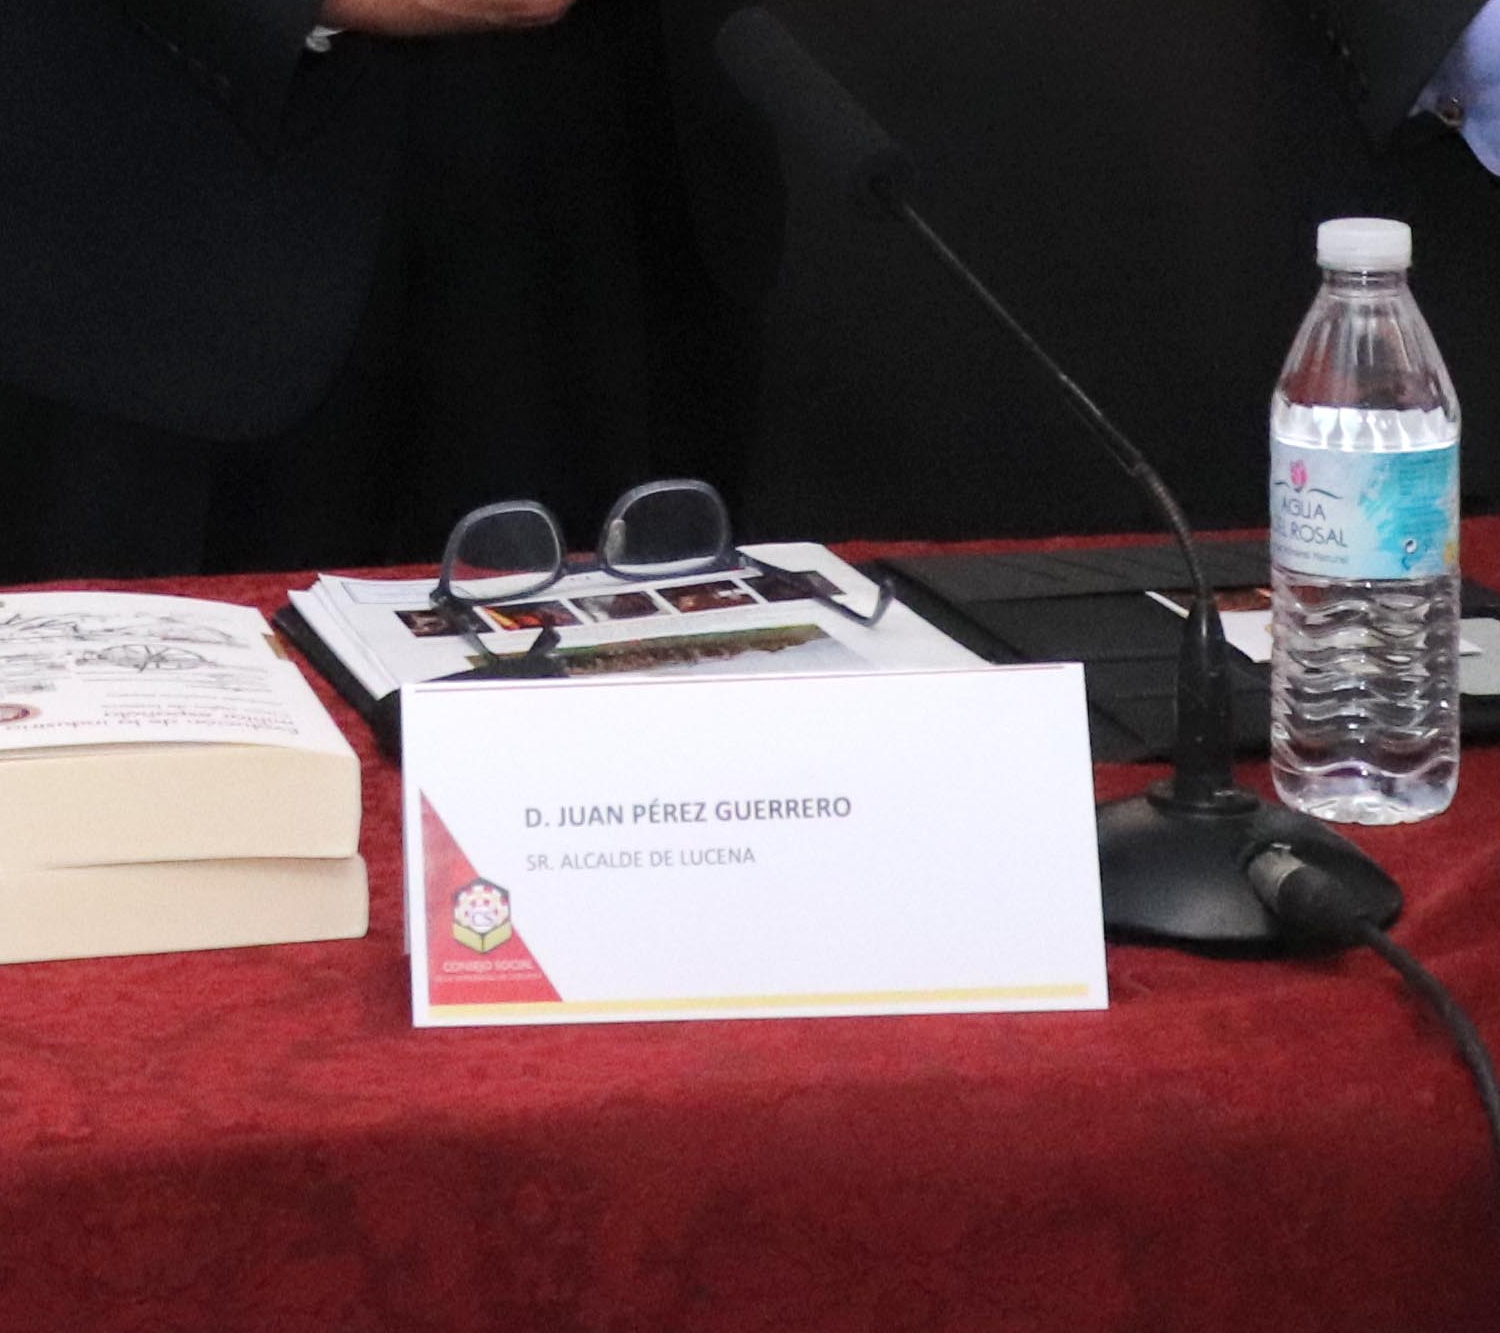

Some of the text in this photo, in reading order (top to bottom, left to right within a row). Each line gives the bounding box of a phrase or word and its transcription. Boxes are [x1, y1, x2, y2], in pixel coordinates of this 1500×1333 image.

[1282, 496, 1327, 522] AGUA
[1291, 521, 1348, 548] ROSAL
[525, 796, 852, 828] D. JUAN PÉREZ GUERRERO
[526, 847, 756, 872] SR. ALCALDE DE LUCENA
